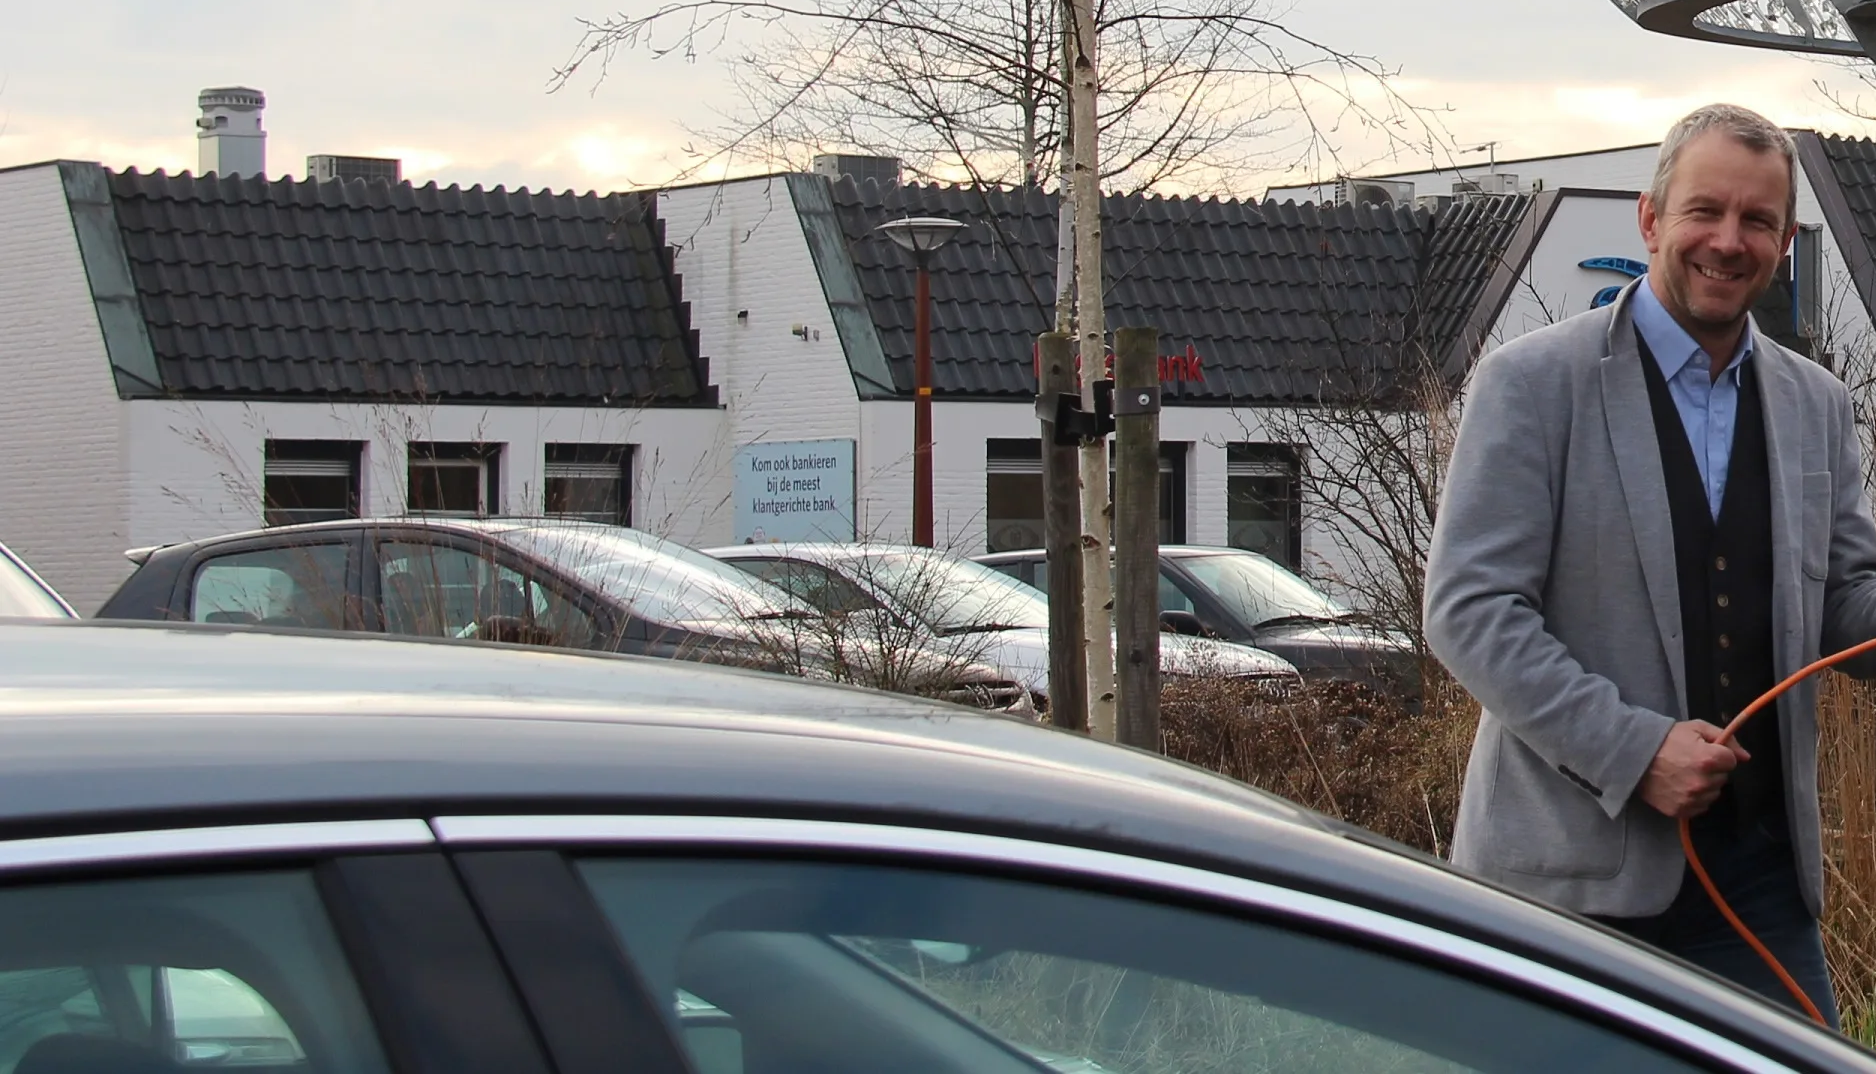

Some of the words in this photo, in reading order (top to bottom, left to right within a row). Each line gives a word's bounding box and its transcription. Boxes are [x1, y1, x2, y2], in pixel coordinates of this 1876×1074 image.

[752, 457, 772, 472] Kom
[774, 455, 790, 472] ook
[792, 454, 837, 471] bankieren
[767, 477, 778, 495] bij
[780, 476, 791, 492] de
[793, 476, 821, 492] meest
[752, 496, 811, 516] klantgerichte
[813, 495, 835, 511] bank
